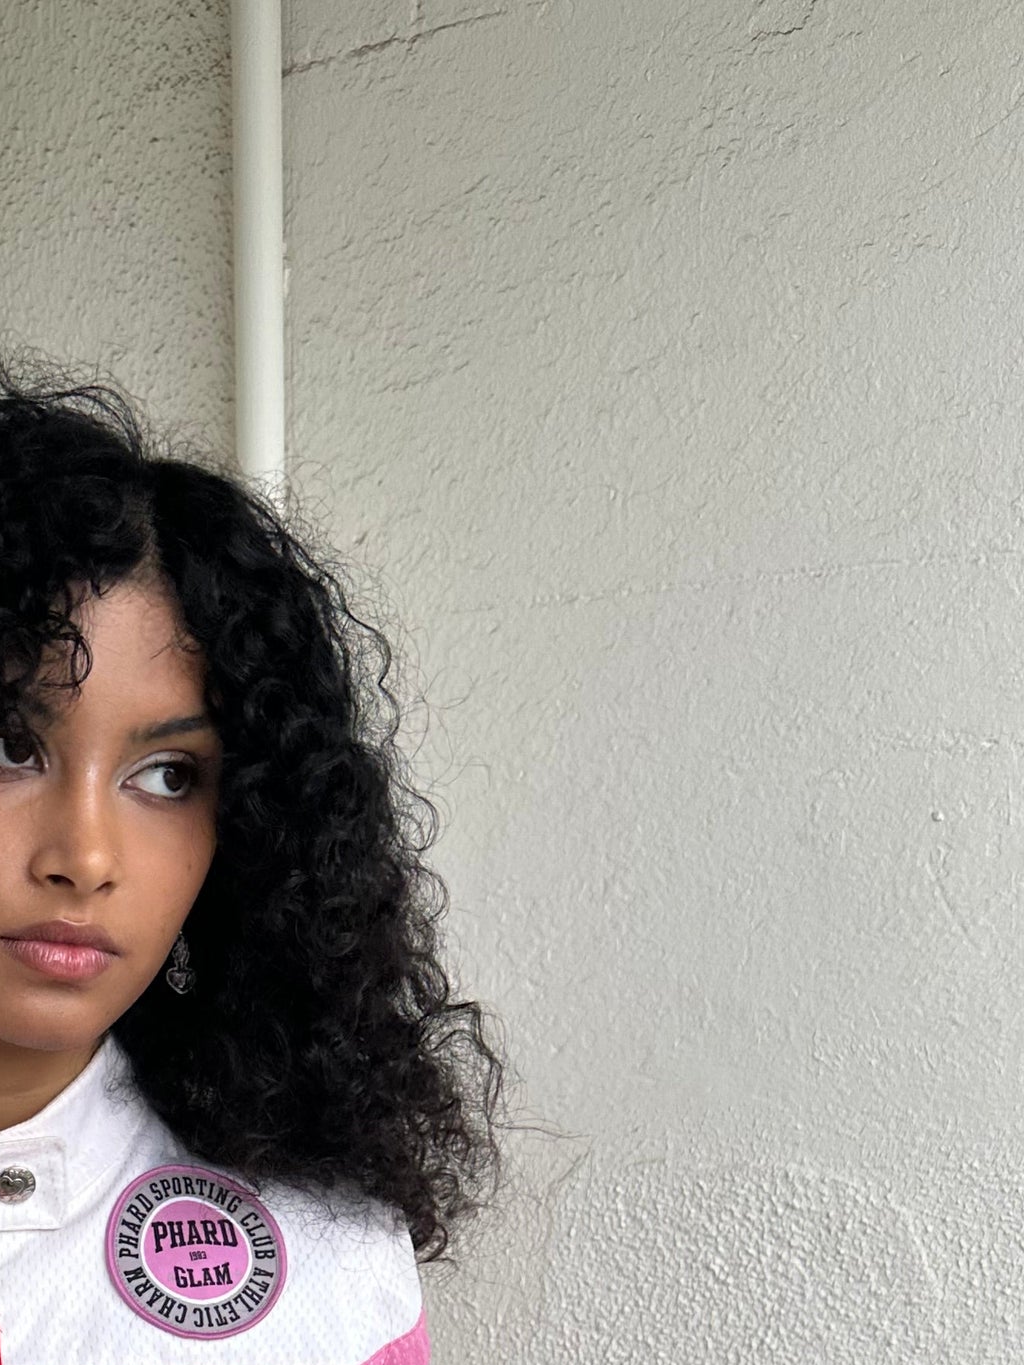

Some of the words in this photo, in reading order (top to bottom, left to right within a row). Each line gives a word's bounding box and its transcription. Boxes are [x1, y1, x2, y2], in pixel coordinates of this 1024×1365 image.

[119, 1193, 154, 1259] PHARD
[149, 1176, 243, 1213] SPORTING
[240, 1212, 275, 1260] CLUB
[151, 1219, 239, 1254] PHARD
[123, 1266, 188, 1324] CHARM
[173, 1262, 234, 1289] GLAM
[193, 1266, 274, 1328] ATHLETIC
